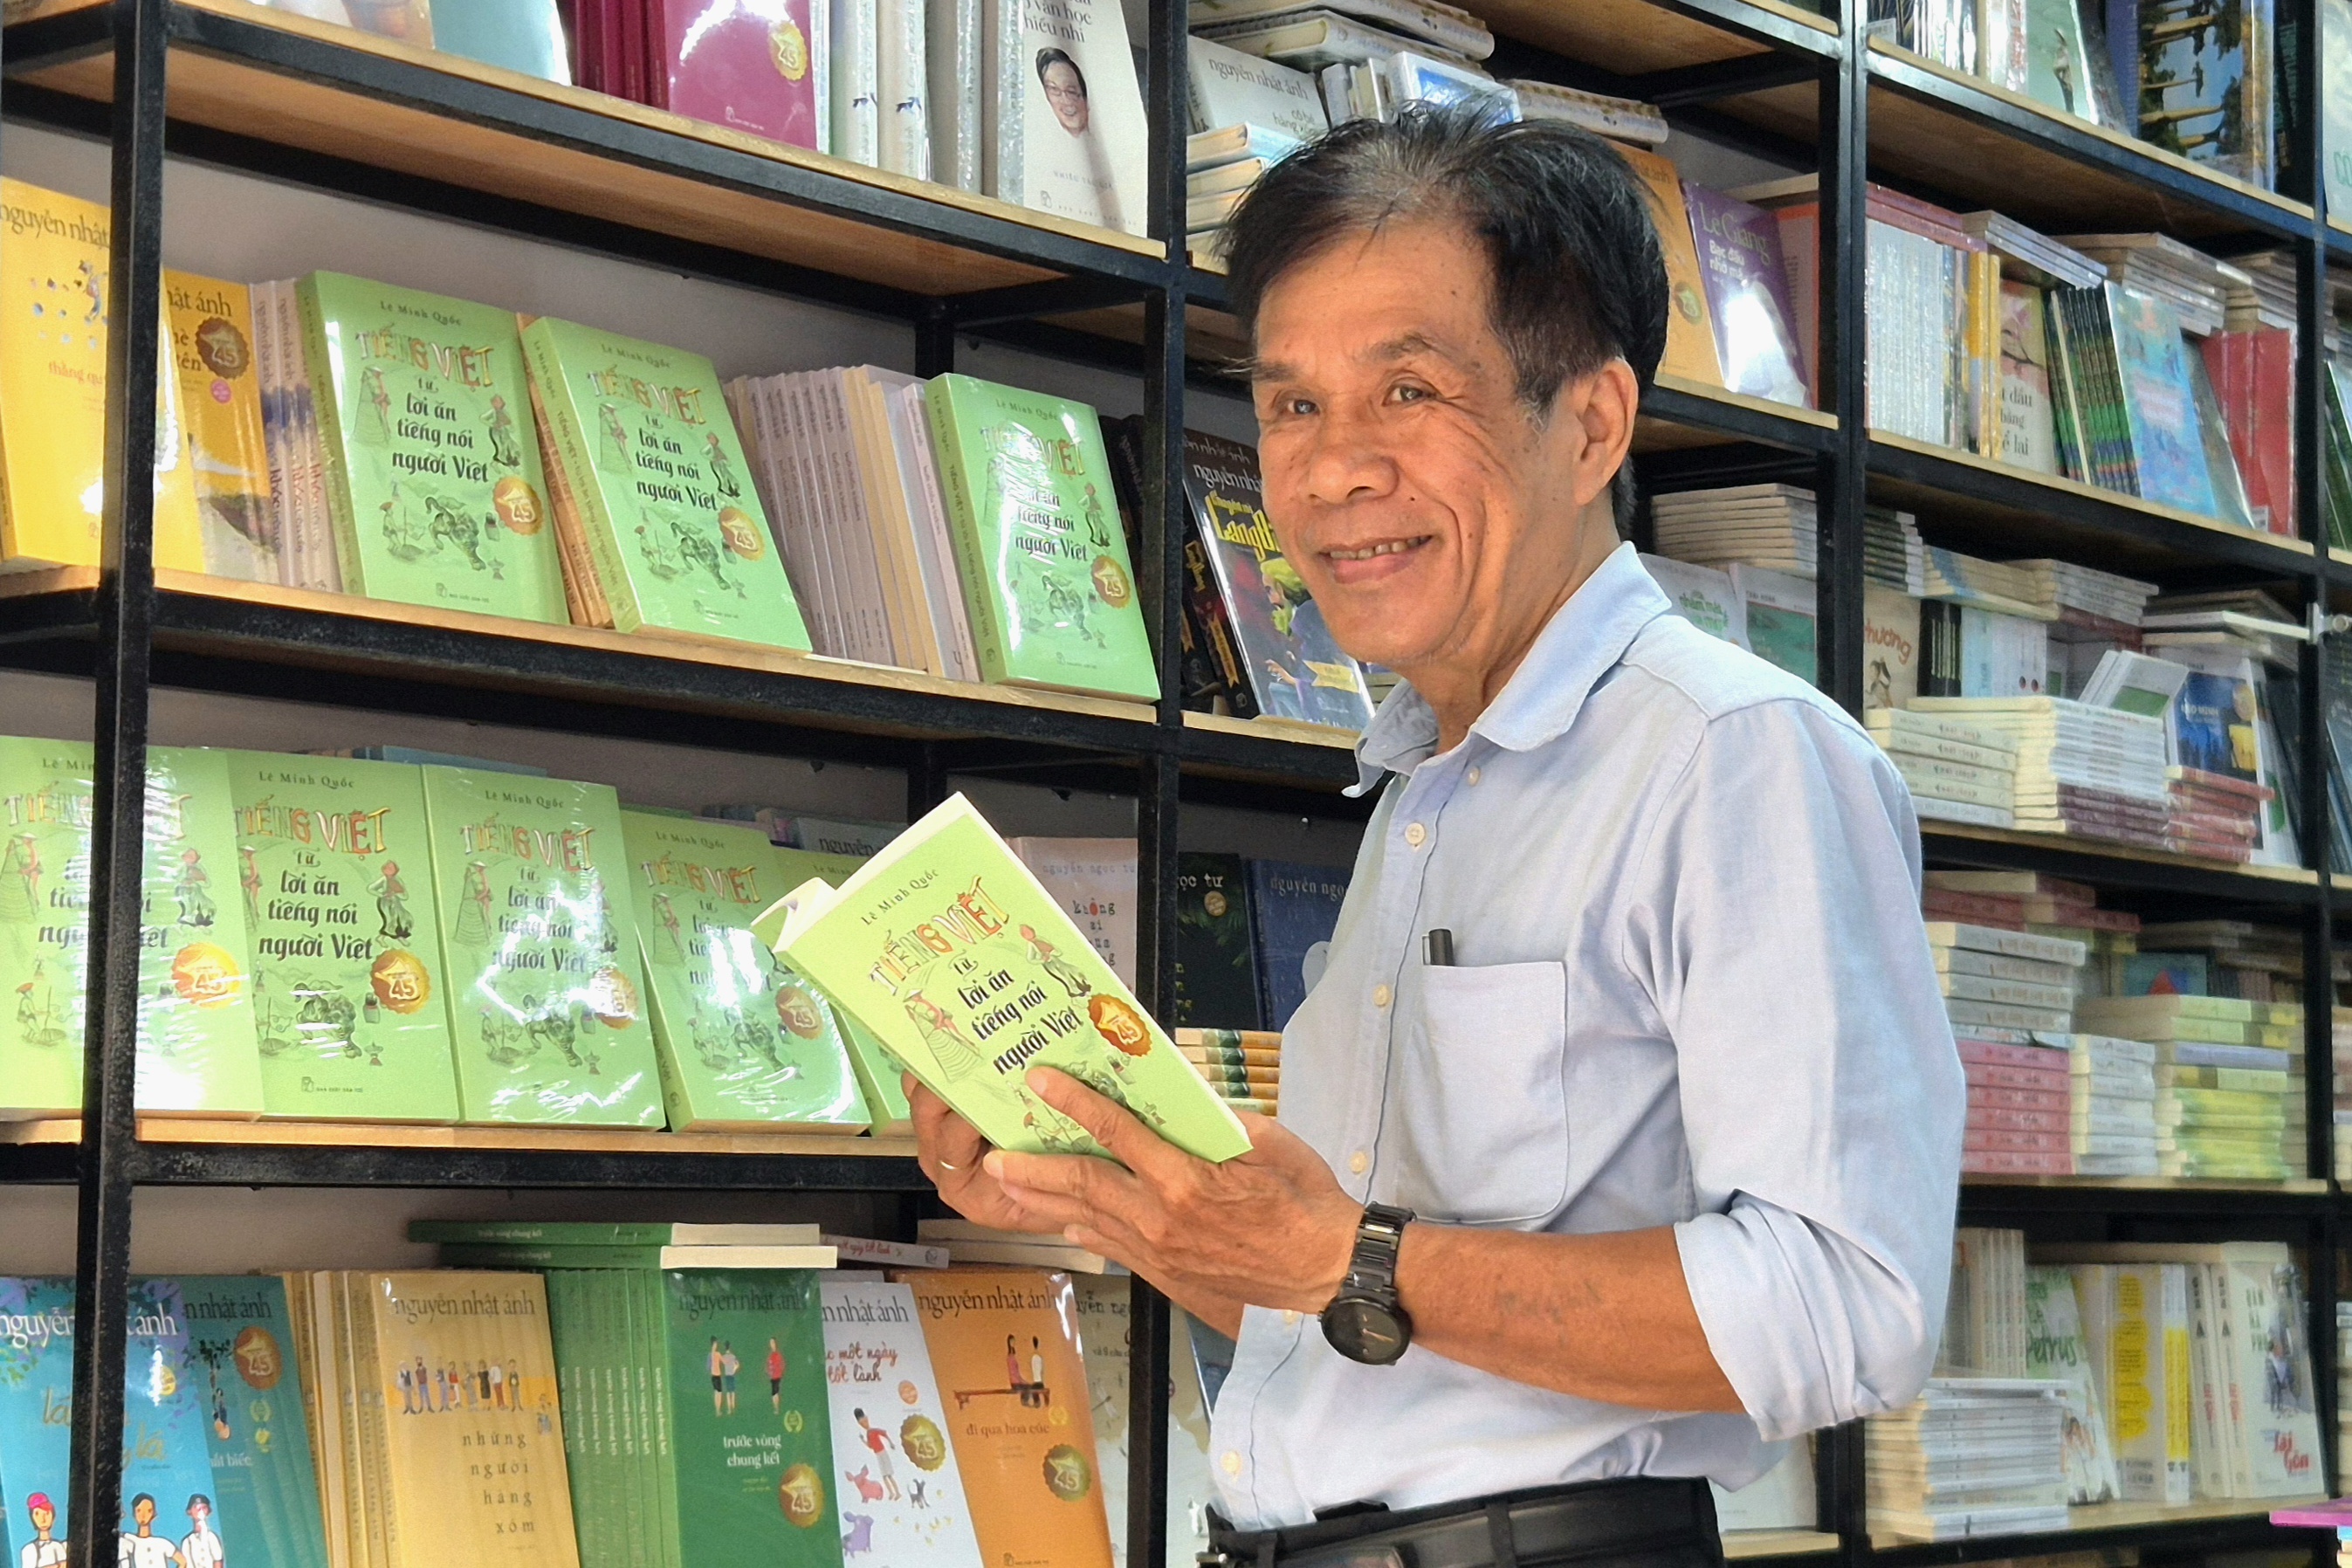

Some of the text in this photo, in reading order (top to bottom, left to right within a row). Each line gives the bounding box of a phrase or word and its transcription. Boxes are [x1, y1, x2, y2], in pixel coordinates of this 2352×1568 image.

[1063, 3, 1091, 25] học
[1025, 15, 1085, 43] hiếu nhi
[196, 291, 232, 316] ánh
[397, 305, 429, 319] Minh
[406, 392, 457, 423] lời ăn
[397, 418, 474, 450] tiếng nói
[392, 449, 447, 476] người
[677, 462, 701, 480] nói
[259, 771, 355, 788] Lê Minh Quốc
[503, 791, 532, 806] Minh
[314, 807, 392, 861] VIỆT
[281, 870, 340, 896] lời ăn
[861, 869, 939, 925] Lê Minh Quốc
[268, 898, 358, 926] tiếng nói
[258, 933, 373, 963] người Việt
[869, 875, 1010, 995] TIẾNG VIỆT
[957, 968, 1014, 1009] lời ăn
[972, 980, 1048, 1041] tiếng nói
[993, 1005, 1083, 1075] người Việt
[240, 1297, 272, 1319] ánh
[462, 1289, 501, 1319] nhật
[503, 1290, 535, 1317] ánh
[836, 1295, 910, 1326] nhật ánh
[918, 1289, 985, 1321] nguyễn
[987, 1284, 1026, 1310] nhật
[136, 1303, 178, 1336] ánh
[980, 1426, 1003, 1438] qua
[726, 1452, 761, 1469] chung
[916, 1441, 938, 1459] 45
[1058, 1469, 1082, 1489] 45
[791, 1491, 815, 1511] 45
